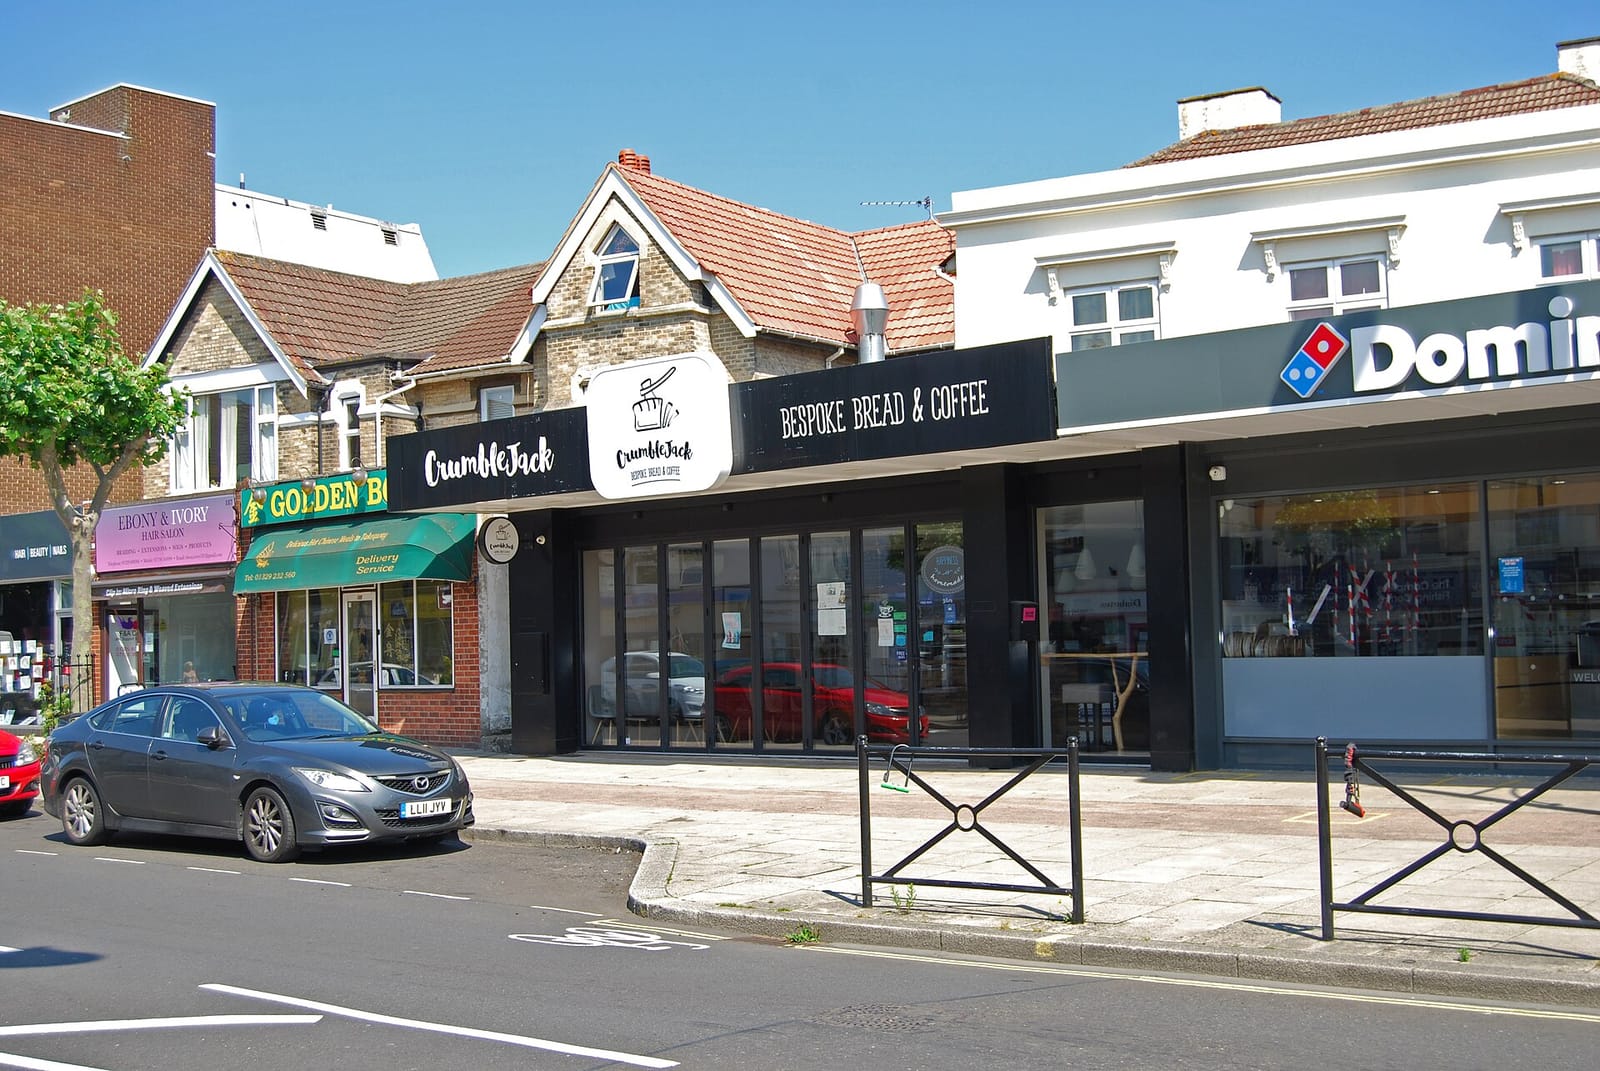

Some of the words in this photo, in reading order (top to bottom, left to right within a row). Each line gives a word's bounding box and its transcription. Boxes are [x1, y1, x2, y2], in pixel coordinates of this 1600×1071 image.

[780, 400, 847, 440] BESPOKE
[851, 391, 905, 430] BREAD
[912, 386, 924, 423] &
[930, 379, 989, 421] COFFEE
[424, 435, 555, 488] CrumbleJack
[616, 439, 694, 470] CrumbleJack
[270, 479, 360, 518] GOLDEN
[366, 476, 387, 506] B
[118, 511, 158, 531] EBONY
[160, 511, 169, 526] &
[171, 506, 209, 525] IVORY
[141, 530, 160, 541] HAIR
[160, 527, 185, 540] SALON
[14, 549, 26, 559] HAIR
[29, 546, 49, 558] BEAUTY
[52, 544, 68, 556] NAILS
[356, 554, 399, 565] Delivery
[356, 564, 395, 574] Service
[410, 803, 428, 816] LL11
[429, 801, 447, 814] JYV
